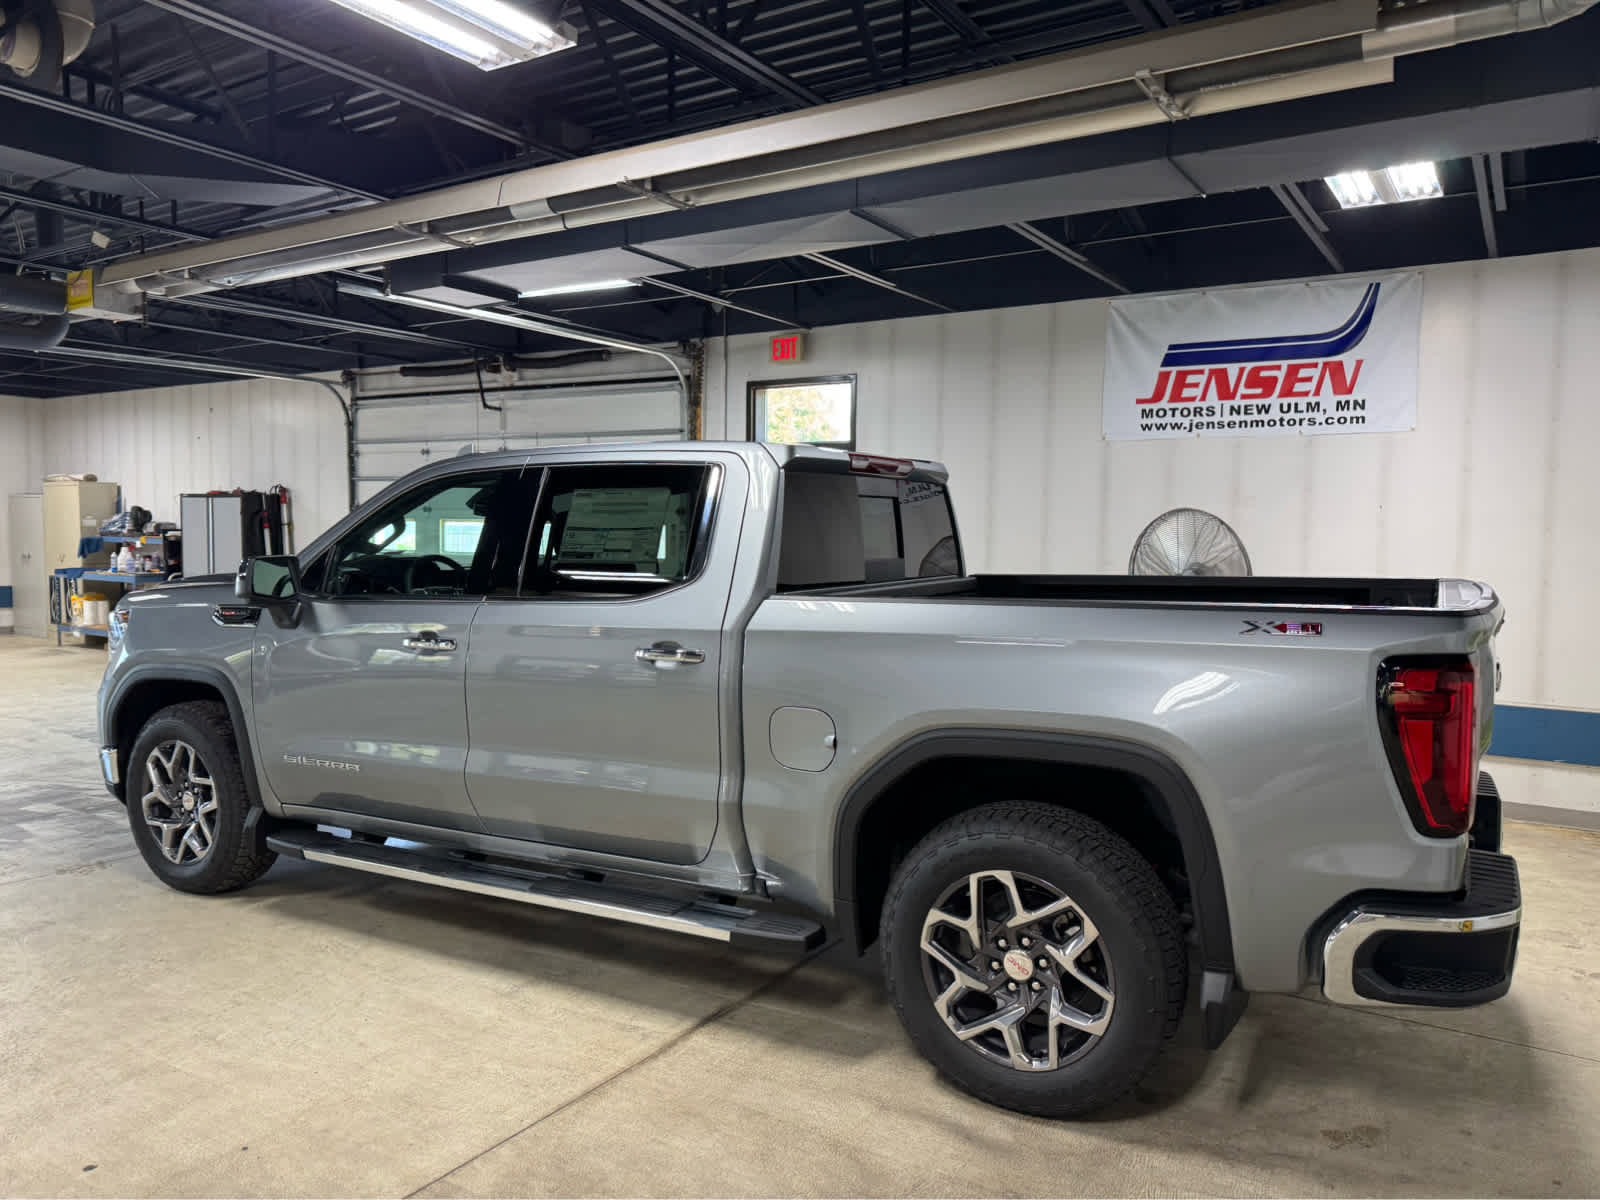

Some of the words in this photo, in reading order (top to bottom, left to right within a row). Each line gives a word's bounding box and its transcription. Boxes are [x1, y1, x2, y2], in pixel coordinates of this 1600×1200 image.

[773, 336, 798, 362] EXIT
[1136, 359, 1364, 405] JENSEN
[1141, 405, 1216, 419] MOTORS
[1229, 403, 1272, 416] NEW
[1279, 401, 1327, 415] ULM,
[1335, 399, 1366, 412] MN
[1140, 415, 1366, 433] www.jensenmotors.com
[283, 754, 360, 772] SIERRA
